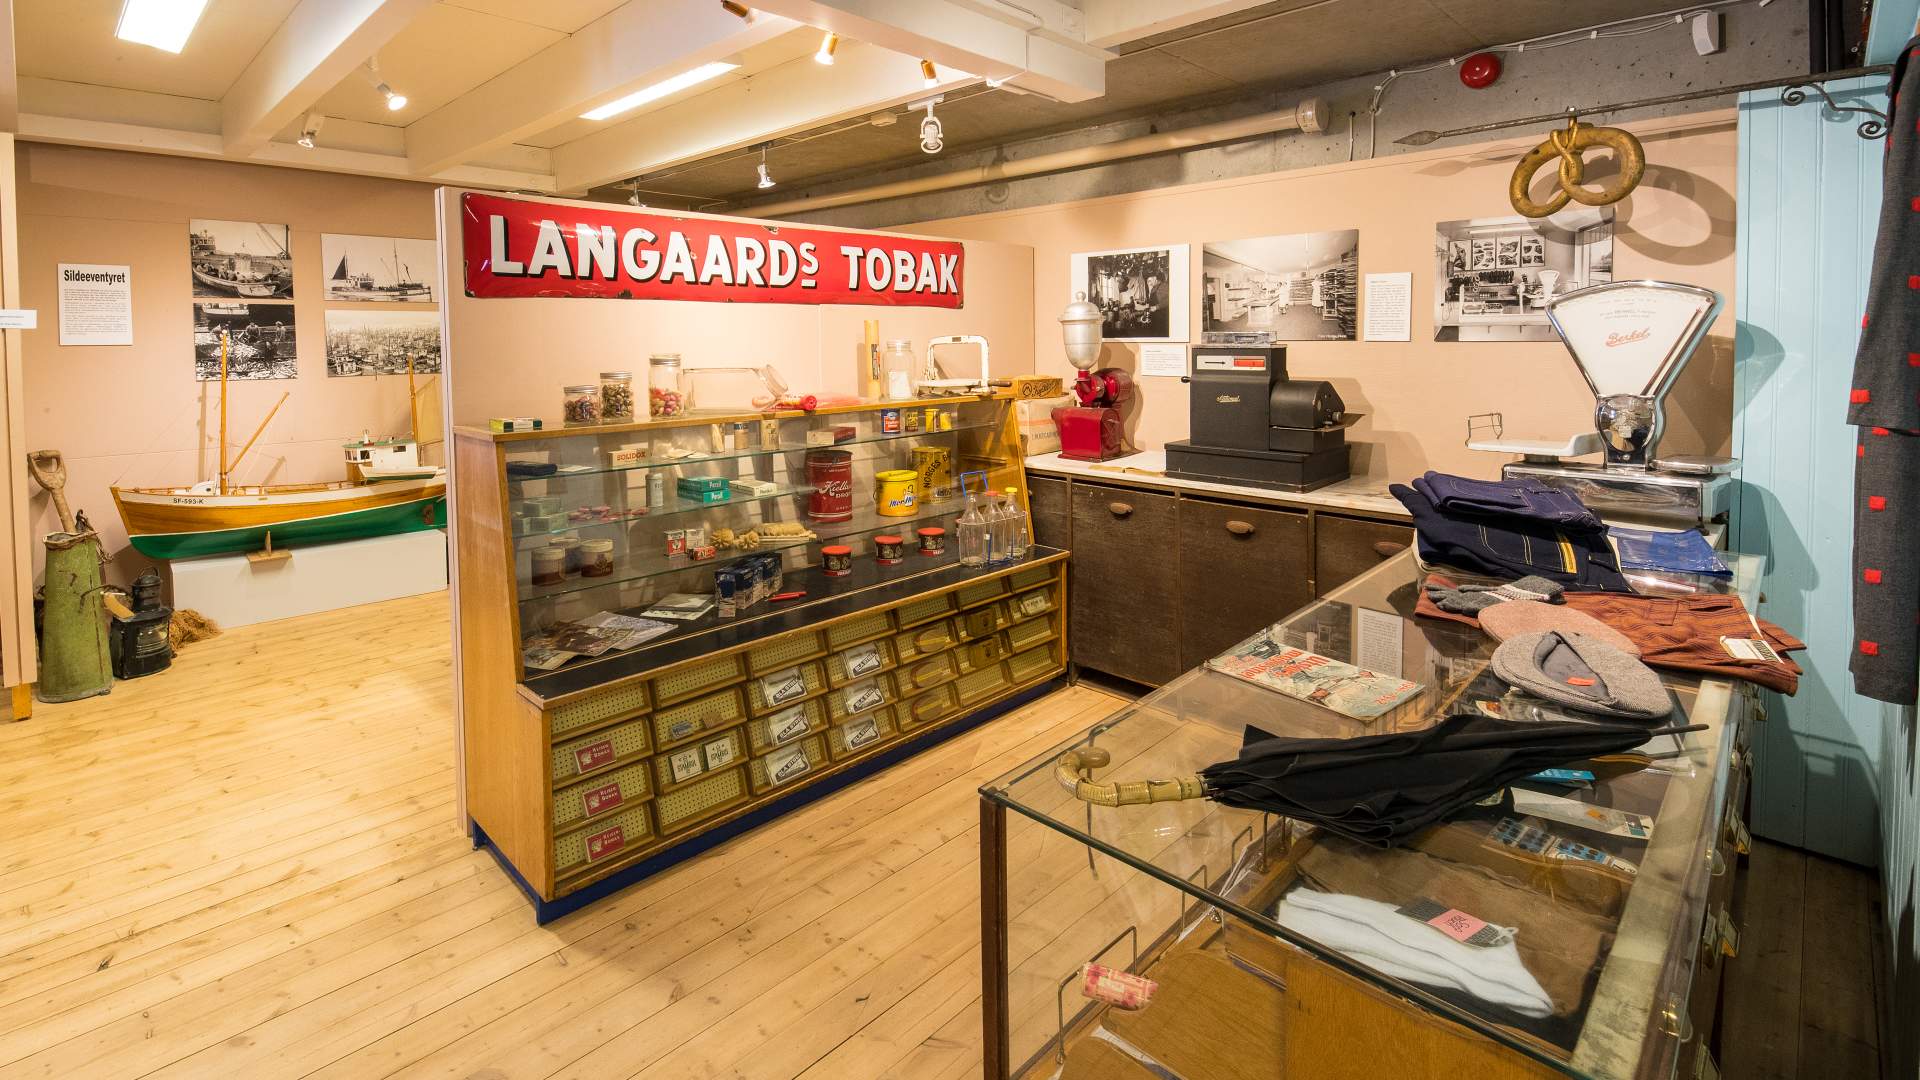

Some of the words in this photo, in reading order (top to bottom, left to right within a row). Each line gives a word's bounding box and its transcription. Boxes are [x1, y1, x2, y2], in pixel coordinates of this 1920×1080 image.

[63, 269, 126, 286] Sildeeventyret
[841, 244, 959, 294] TOBAK
[923, 459, 941, 489] NORGES
